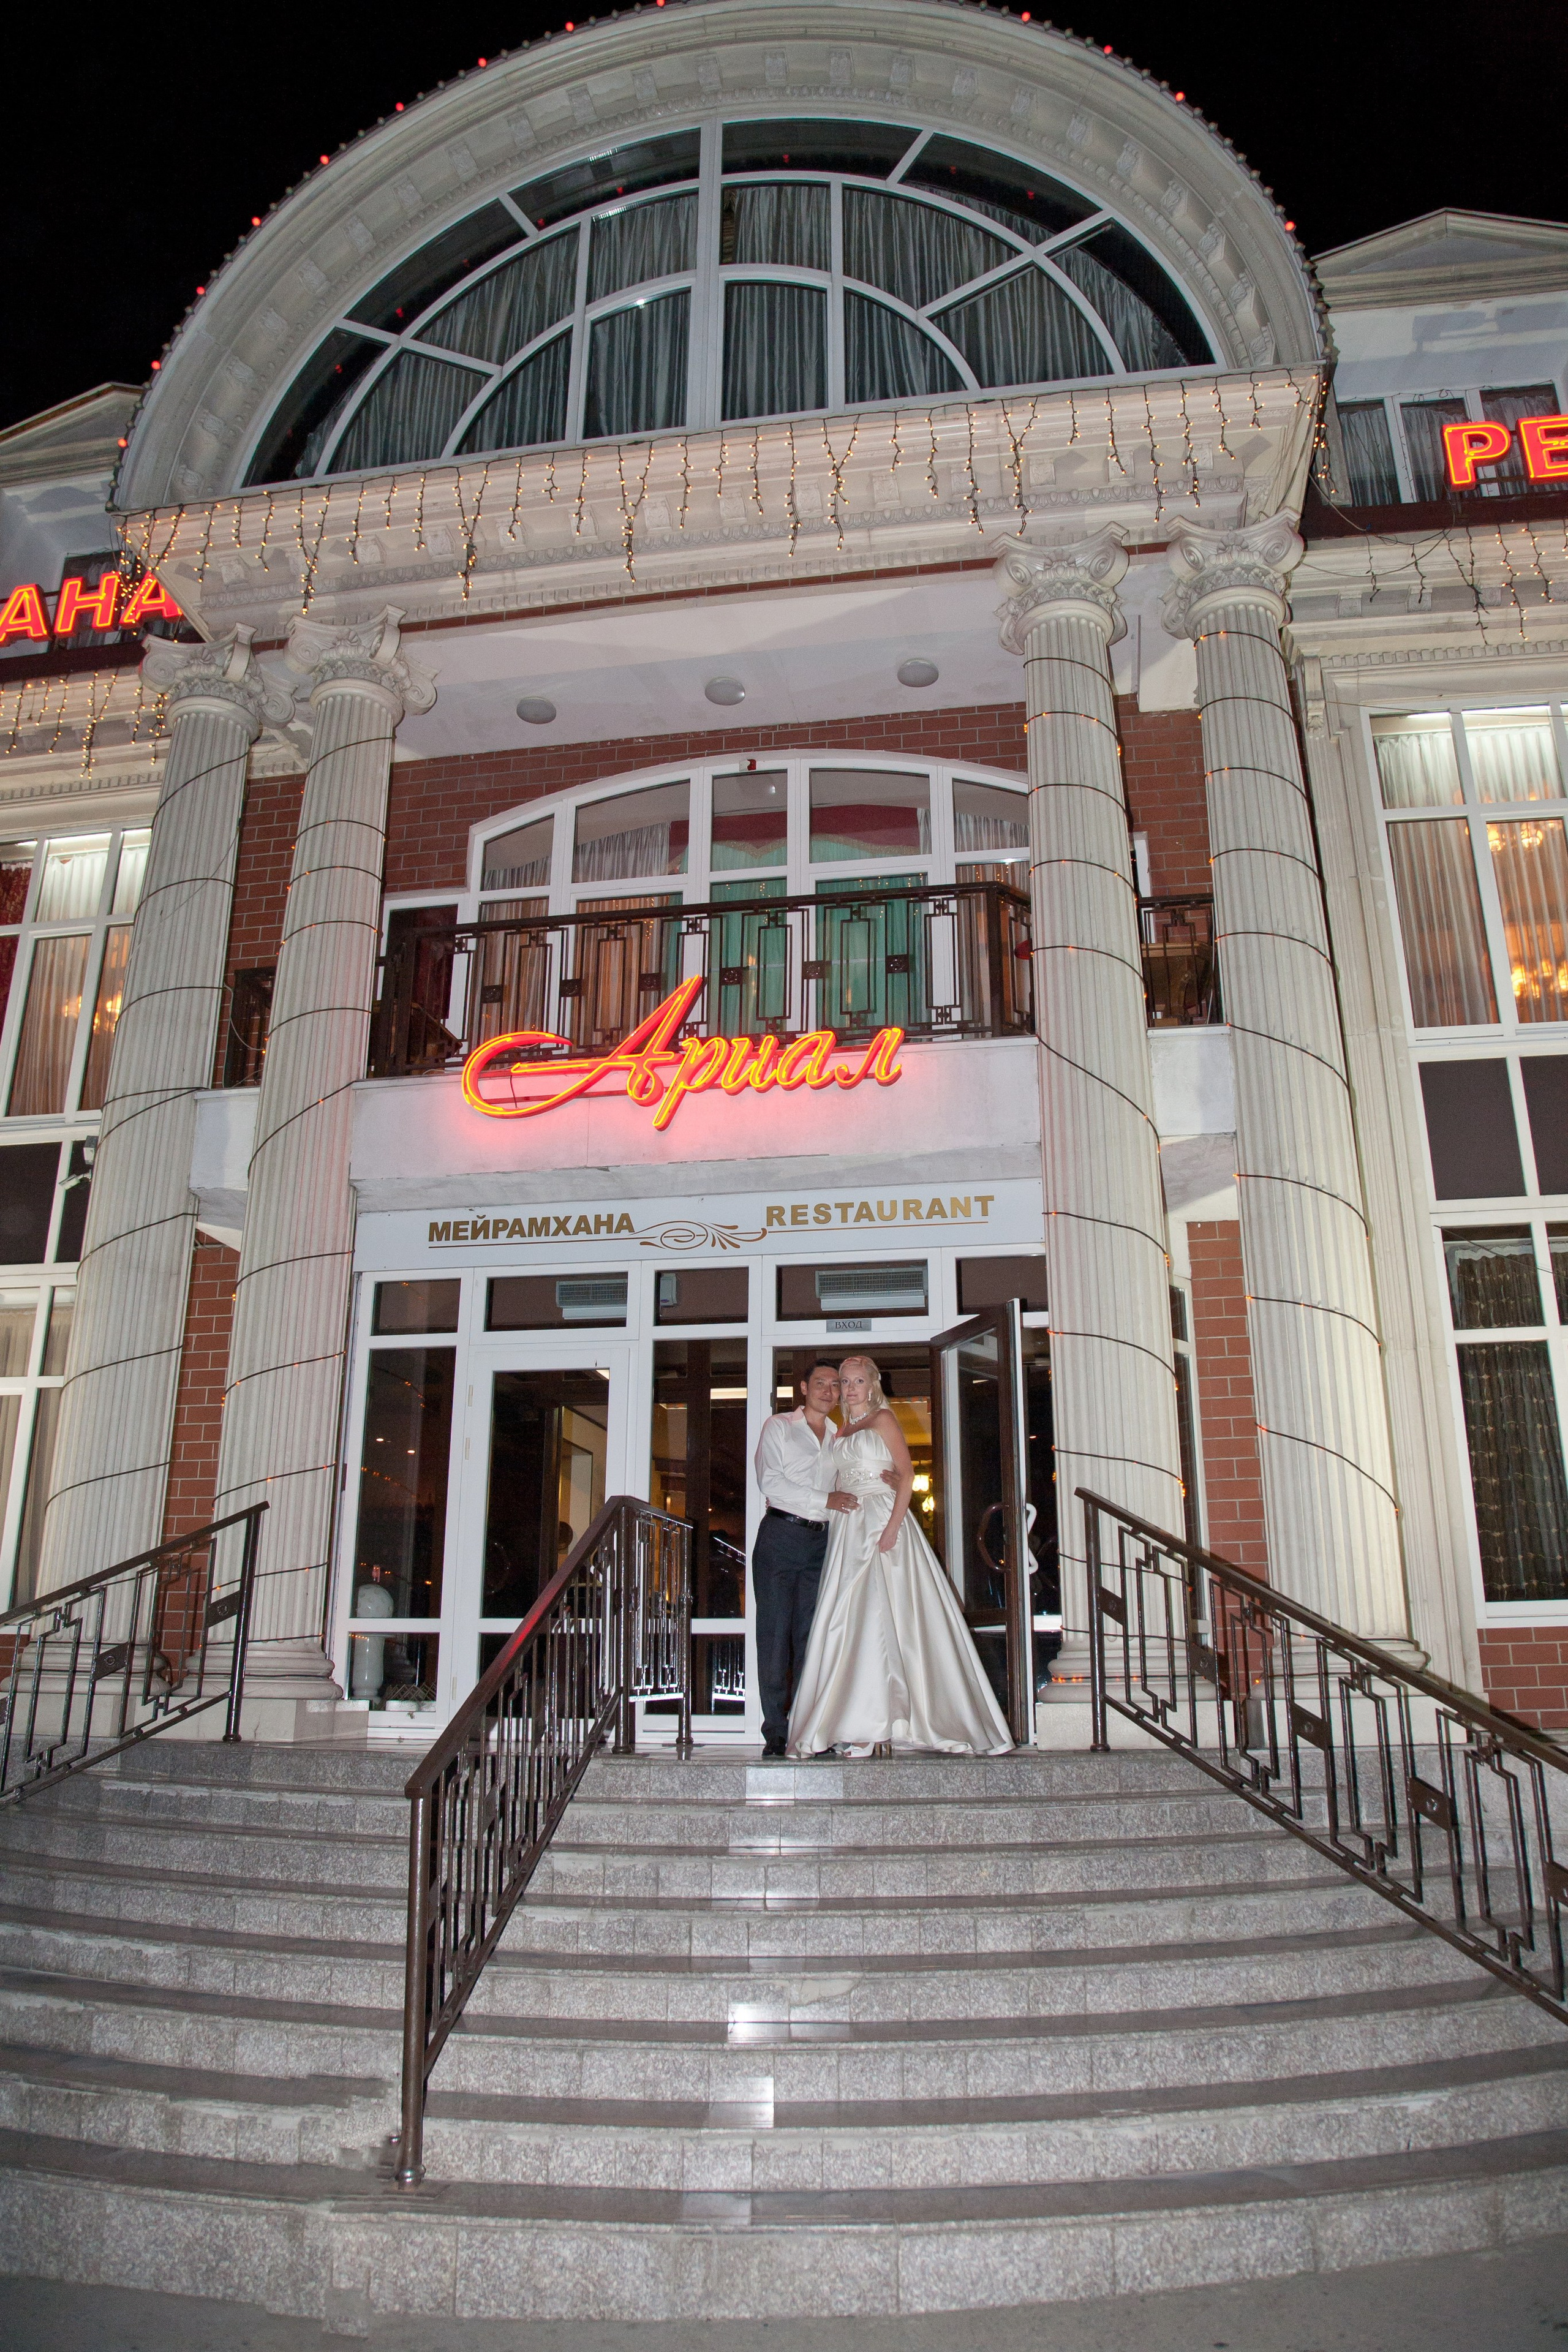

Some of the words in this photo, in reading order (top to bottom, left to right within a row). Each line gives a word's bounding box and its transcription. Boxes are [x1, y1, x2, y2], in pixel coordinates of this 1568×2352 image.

[462, 973, 906, 1132] Ариал
[766, 1195, 995, 1227] RESTAURANT
[428, 1213, 635, 1242] МЕЙРАМХАНА
[834, 1321, 863, 1329] ВХОД
